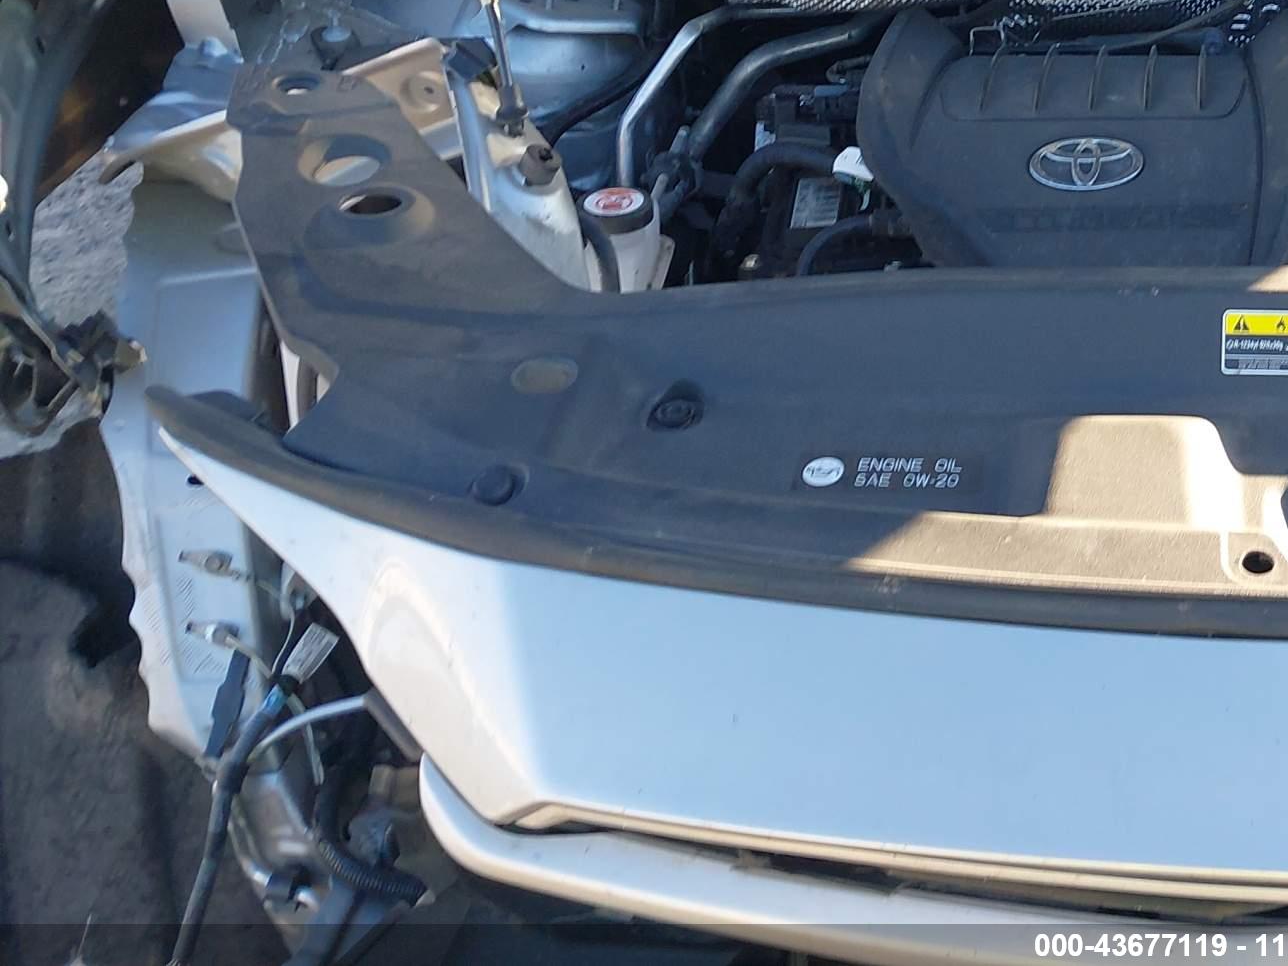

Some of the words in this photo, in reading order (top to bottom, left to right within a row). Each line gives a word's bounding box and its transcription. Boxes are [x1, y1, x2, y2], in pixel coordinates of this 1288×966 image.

[857, 456, 924, 472] ENGINE
[935, 459, 962, 473] OIL
[854, 472, 892, 488] SAE
[903, 472, 960, 489] 0W-20
